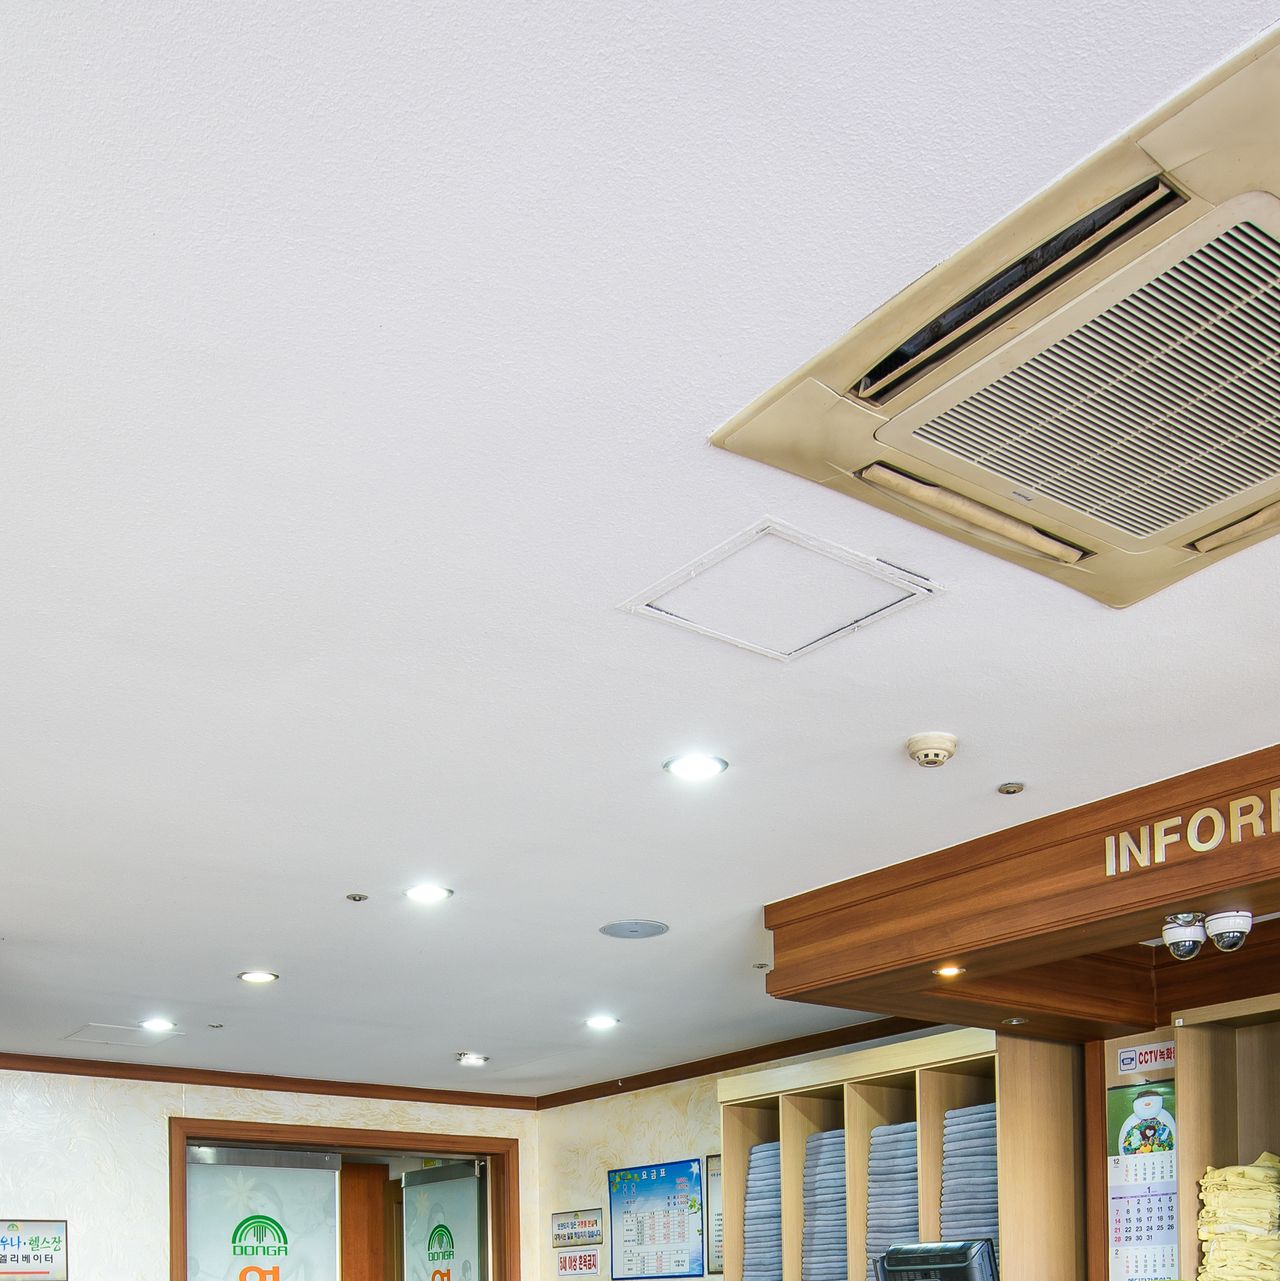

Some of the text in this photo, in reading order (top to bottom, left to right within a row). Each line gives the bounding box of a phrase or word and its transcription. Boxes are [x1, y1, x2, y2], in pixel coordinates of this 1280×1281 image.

[641, 1168, 666, 1180] 요금표
[232, 1244, 288, 1256] DONGA
[427, 1250, 455, 1262] DONGA
[568, 1255, 577, 1271] 이상
[579, 1253, 597, 1270] 혼욕금지
